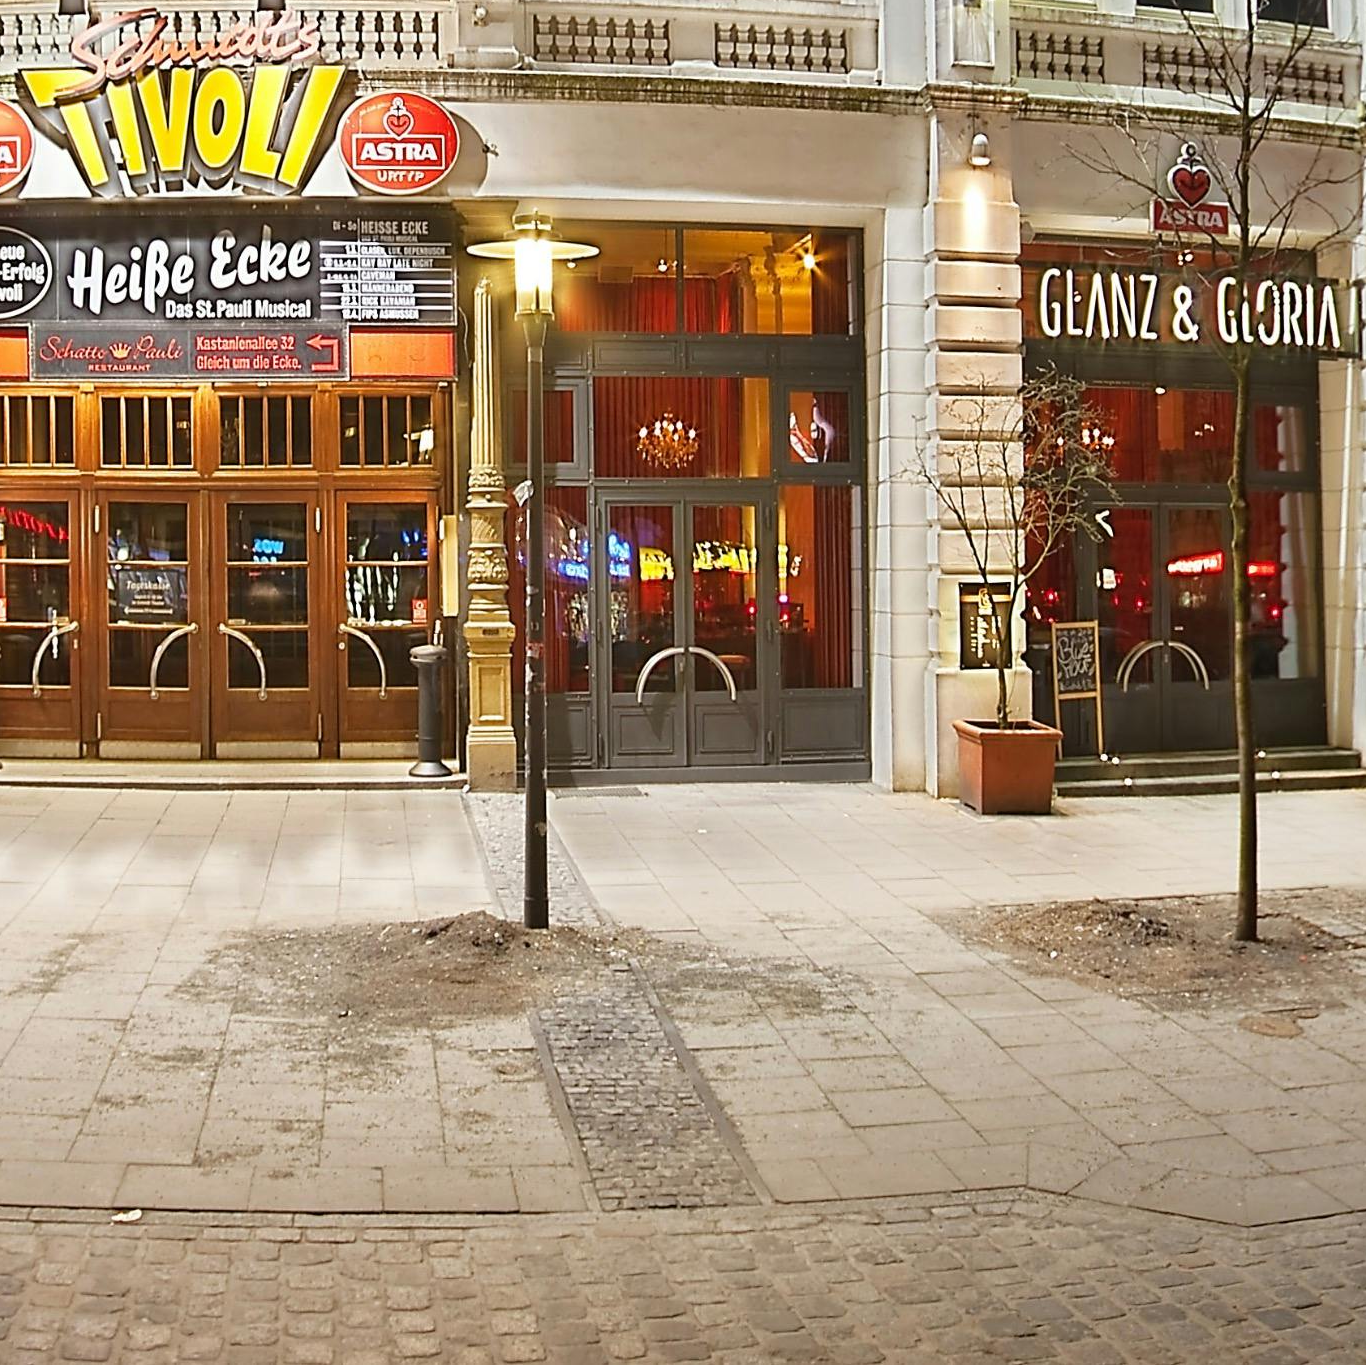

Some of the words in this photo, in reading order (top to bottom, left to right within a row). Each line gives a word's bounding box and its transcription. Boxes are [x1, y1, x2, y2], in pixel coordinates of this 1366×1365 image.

[54, 8, 321, 98] Schmidts
[22, 63, 346, 188] TIVOLI
[360, 142, 438, 162] ASTRA
[376, 168, 425, 184] URTYP
[361, 221, 399, 235] HEISSE
[402, 221, 428, 235] ECKE
[1159, 209, 1226, 229] ASTRA
[66, 239, 195, 315] Heiße
[210, 224, 311, 289] Ecke
[412, 259, 433, 268] NIGHT
[165, 299, 193, 319] Das
[217, 299, 252, 319] Pauli
[255, 299, 311, 319] Musical
[1039, 268, 1159, 341] GLANZ
[1172, 285, 1201, 342] &
[1217, 277, 1341, 349] GLORIA
[133, 335, 184, 360] Pauli
[196, 336, 278, 351] Kastanienallee
[280, 336, 295, 350] 32
[88, 364, 151, 372] RESTAURANT
[197, 355, 230, 370] Gleich
[233, 358, 250, 370] um
[253, 355, 270, 370] die
[272, 355, 302, 370] Ecke.
